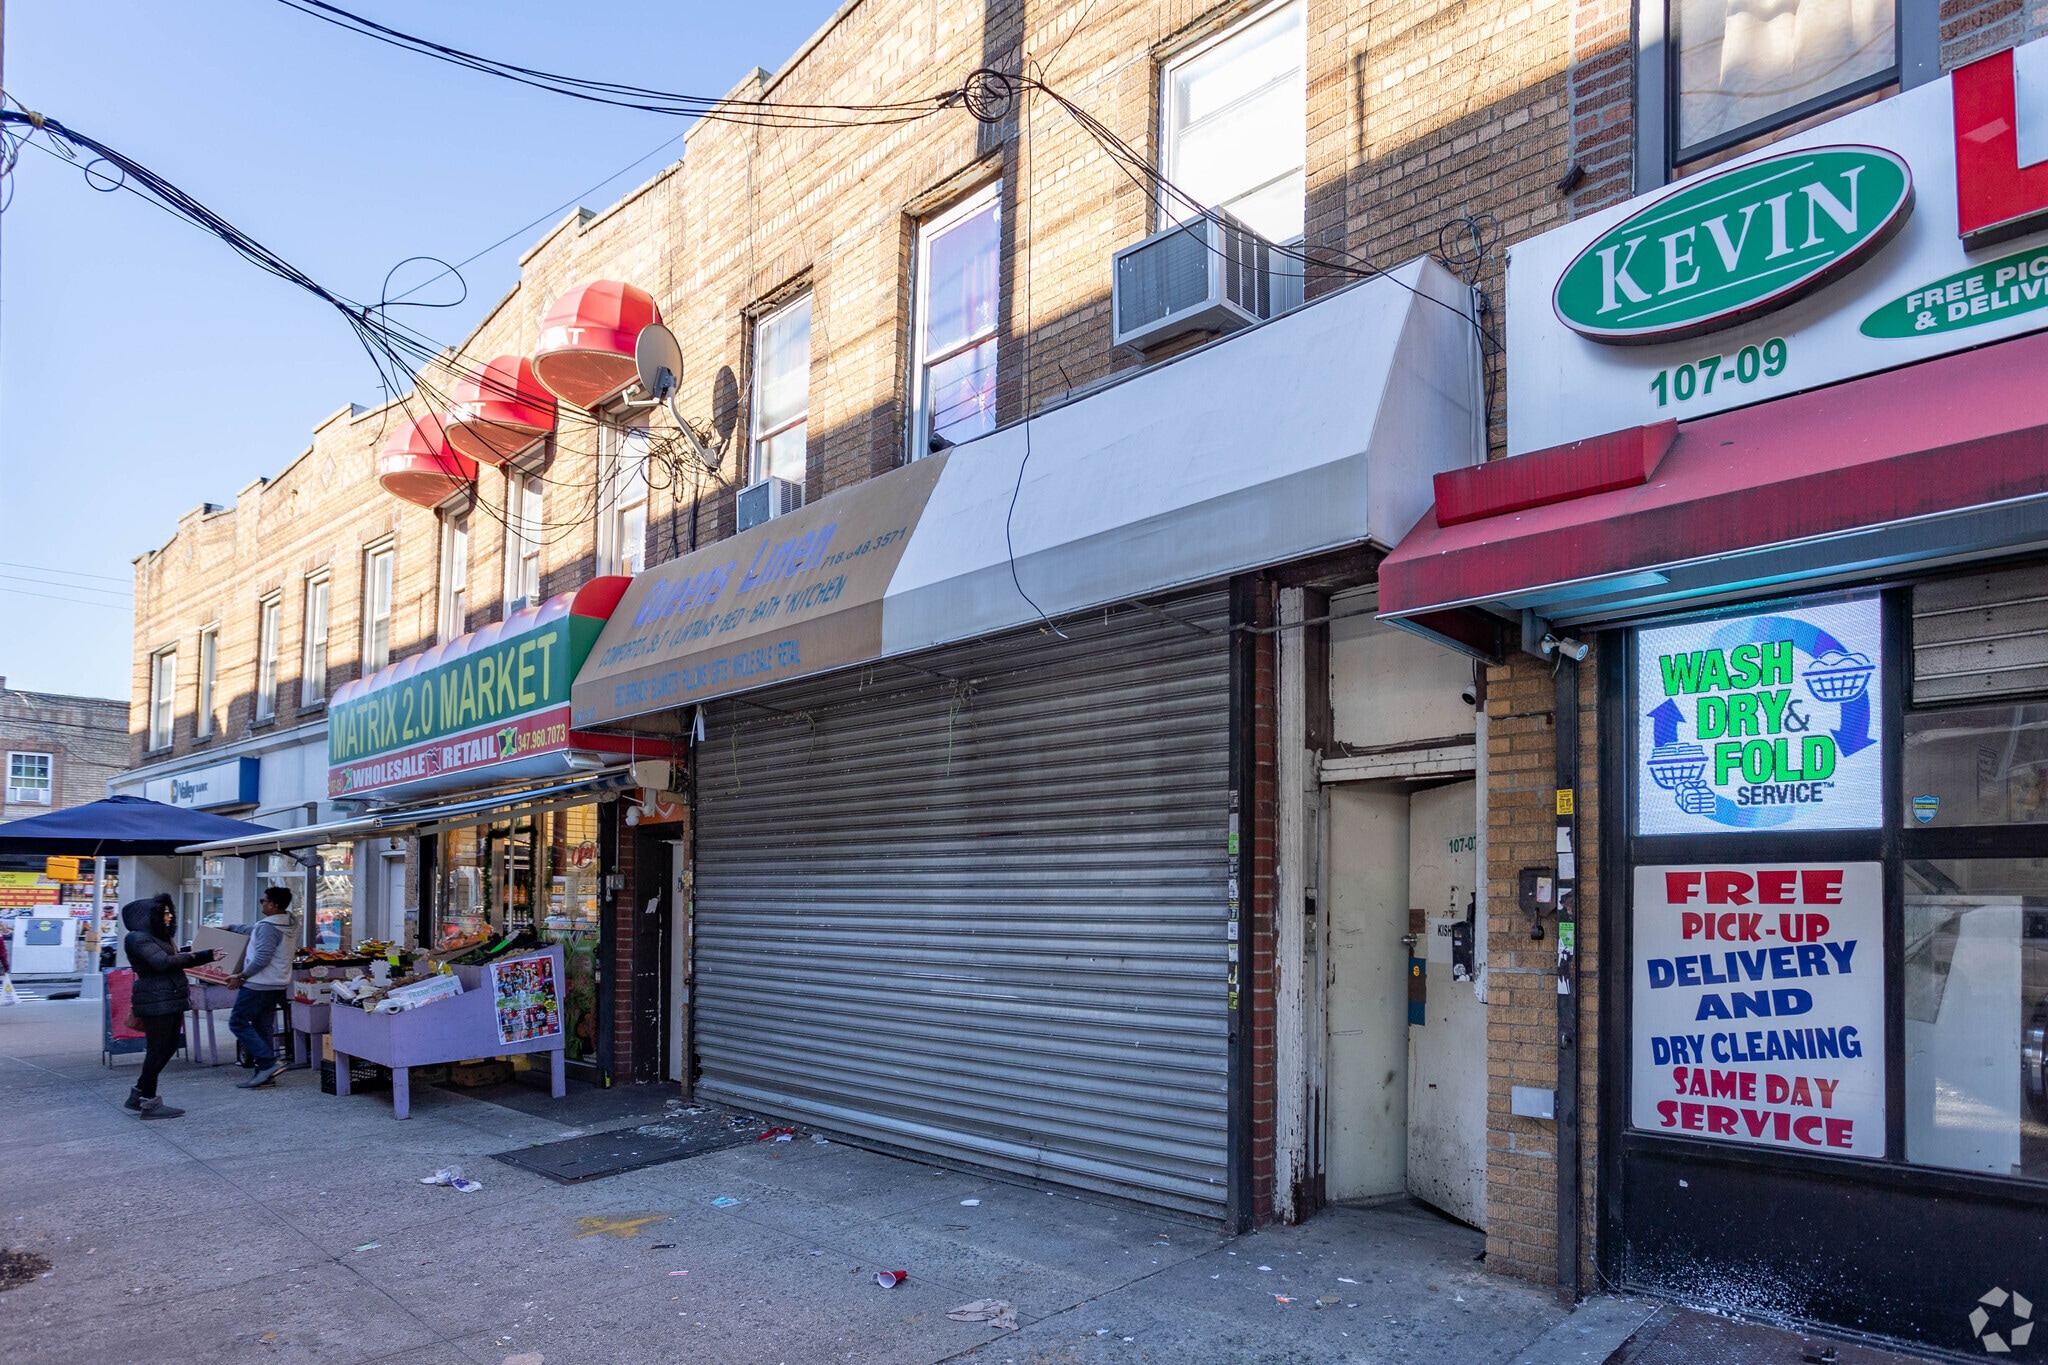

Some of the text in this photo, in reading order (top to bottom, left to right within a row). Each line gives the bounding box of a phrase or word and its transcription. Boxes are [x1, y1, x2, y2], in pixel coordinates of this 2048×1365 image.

[1596, 165, 1865, 315] KEVIN
[1906, 275, 1984, 314] FREE
[1914, 276, 2048, 331] & DELIV
[1650, 337, 1787, 408] 107-09
[633, 522, 837, 627] Queens Linen
[669, 614, 719, 647] CURTAINS
[718, 607, 744, 634] BED
[748, 596, 780, 623] BATH
[788, 574, 848, 614] KITCHEN
[778, 639, 801, 667] RETAIL
[1659, 639, 1794, 696] WASH
[333, 631, 557, 760] MATRIX 2.0 MARKET
[1697, 689, 1810, 740] DRY &
[352, 758, 426, 788] WHOLESALE
[442, 735, 497, 769] RETAIL
[517, 724, 566, 752] 347.960.7073
[1714, 735, 1836, 786] FOLD
[1665, 870, 1844, 906] FREE
[1681, 912, 1830, 943] PICK-UP
[1647, 940, 1858, 989] DELIVERY
[408, 988, 429, 999] FRESH
[1695, 988, 1813, 1021] AND
[1651, 1025, 1862, 1066] DRY CLEANING
[1673, 1066, 1839, 1109] SAME DAY
[1656, 1100, 1854, 1149] SERVICE
